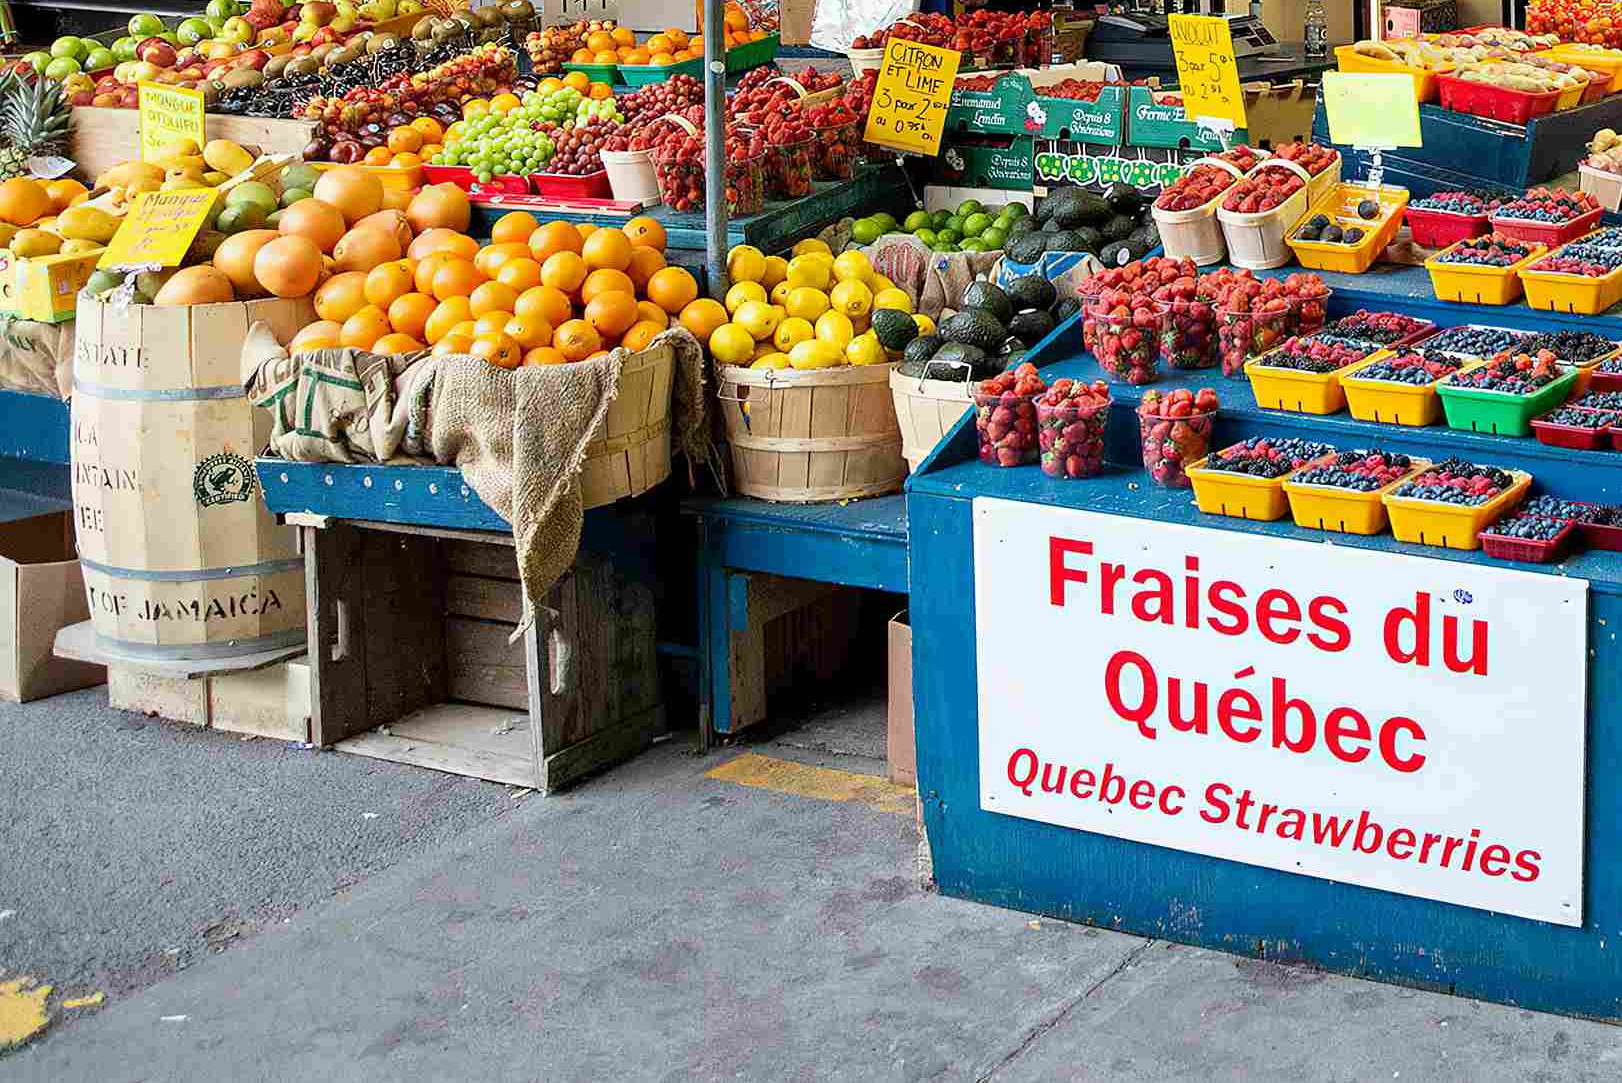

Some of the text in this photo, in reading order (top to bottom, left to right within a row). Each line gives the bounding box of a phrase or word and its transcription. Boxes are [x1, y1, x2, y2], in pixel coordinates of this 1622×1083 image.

[887, 64, 945, 94] ET LIME
[890, 43, 944, 69] CITRON
[101, 591, 128, 616] OF
[138, 588, 282, 623] JAMAICA
[1049, 536, 1489, 676] Fraises du
[1104, 650, 1426, 773] Québec
[1007, 748, 1541, 882] Quebec Strawberries
